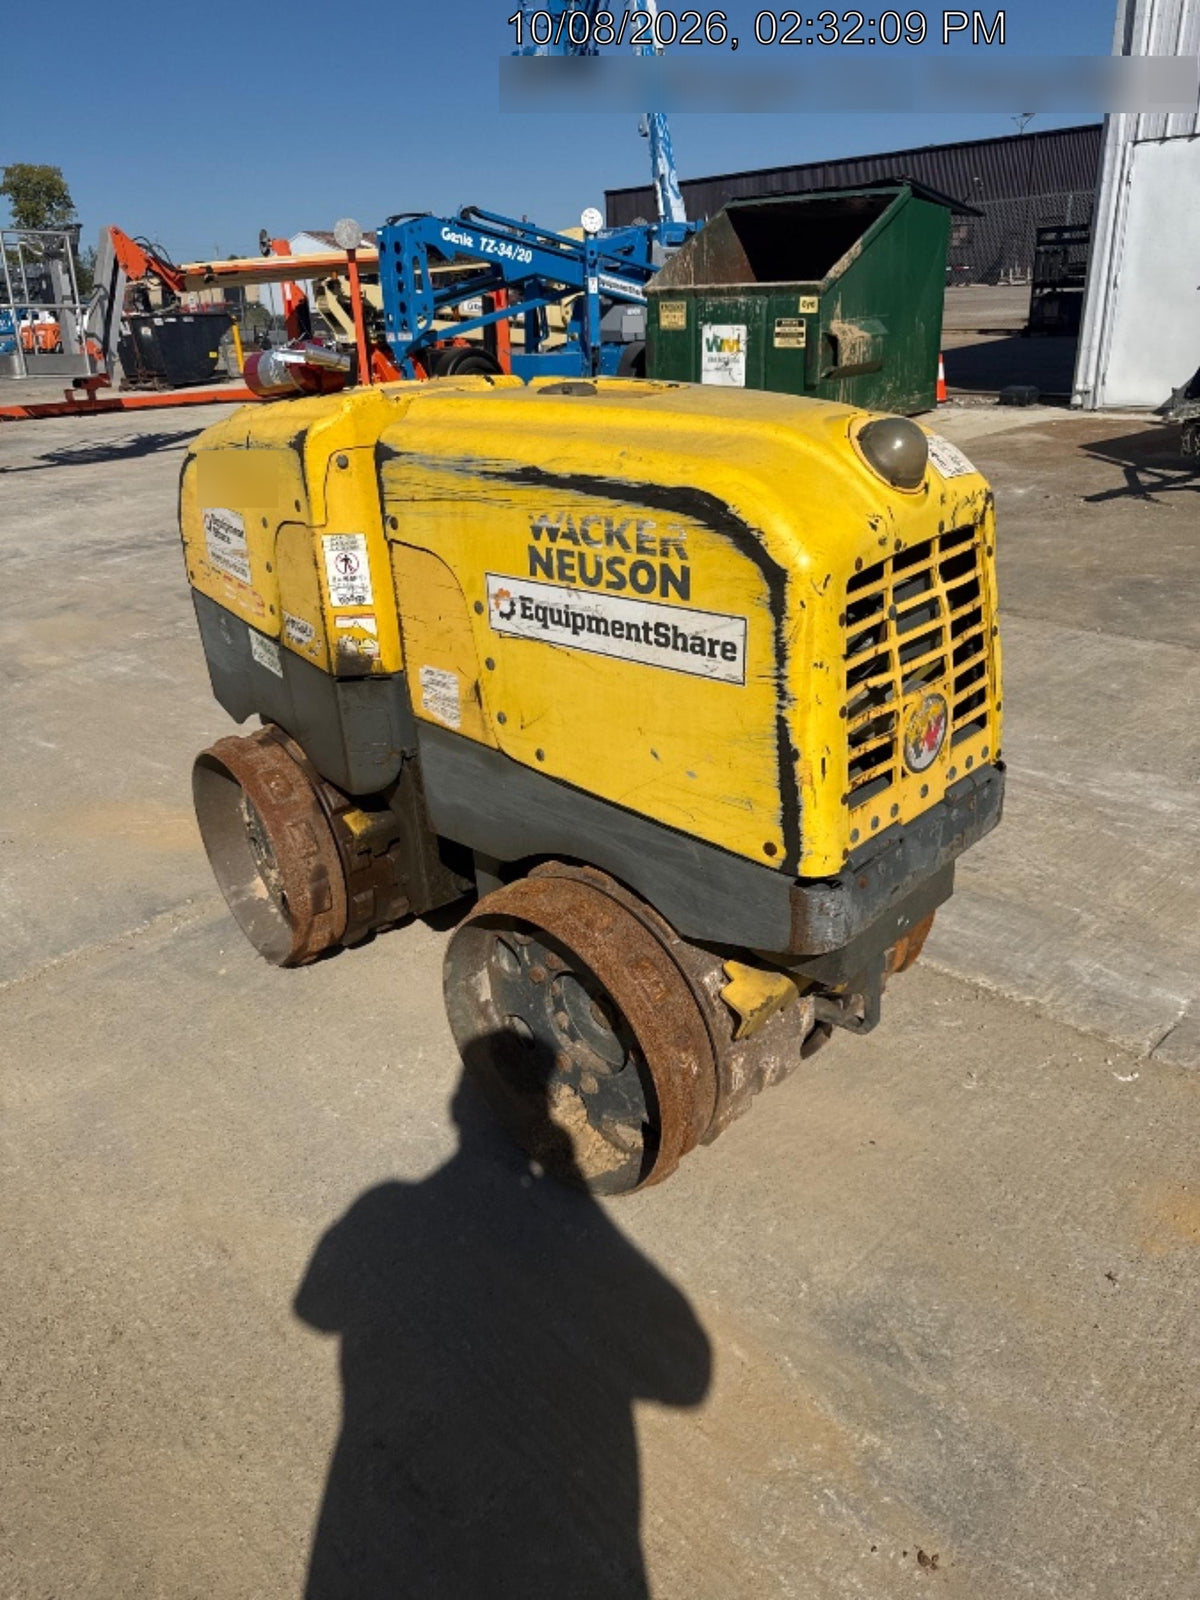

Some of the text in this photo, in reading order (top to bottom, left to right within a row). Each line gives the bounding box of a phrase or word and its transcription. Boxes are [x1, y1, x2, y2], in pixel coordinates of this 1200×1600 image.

[441, 227, 532, 264] Genie TZ-34/20
[705, 336, 740, 353] WM
[530, 512, 689, 560] WACKER
[528, 544, 691, 600] NEUSON
[519, 595, 738, 662] EquipmentShare
